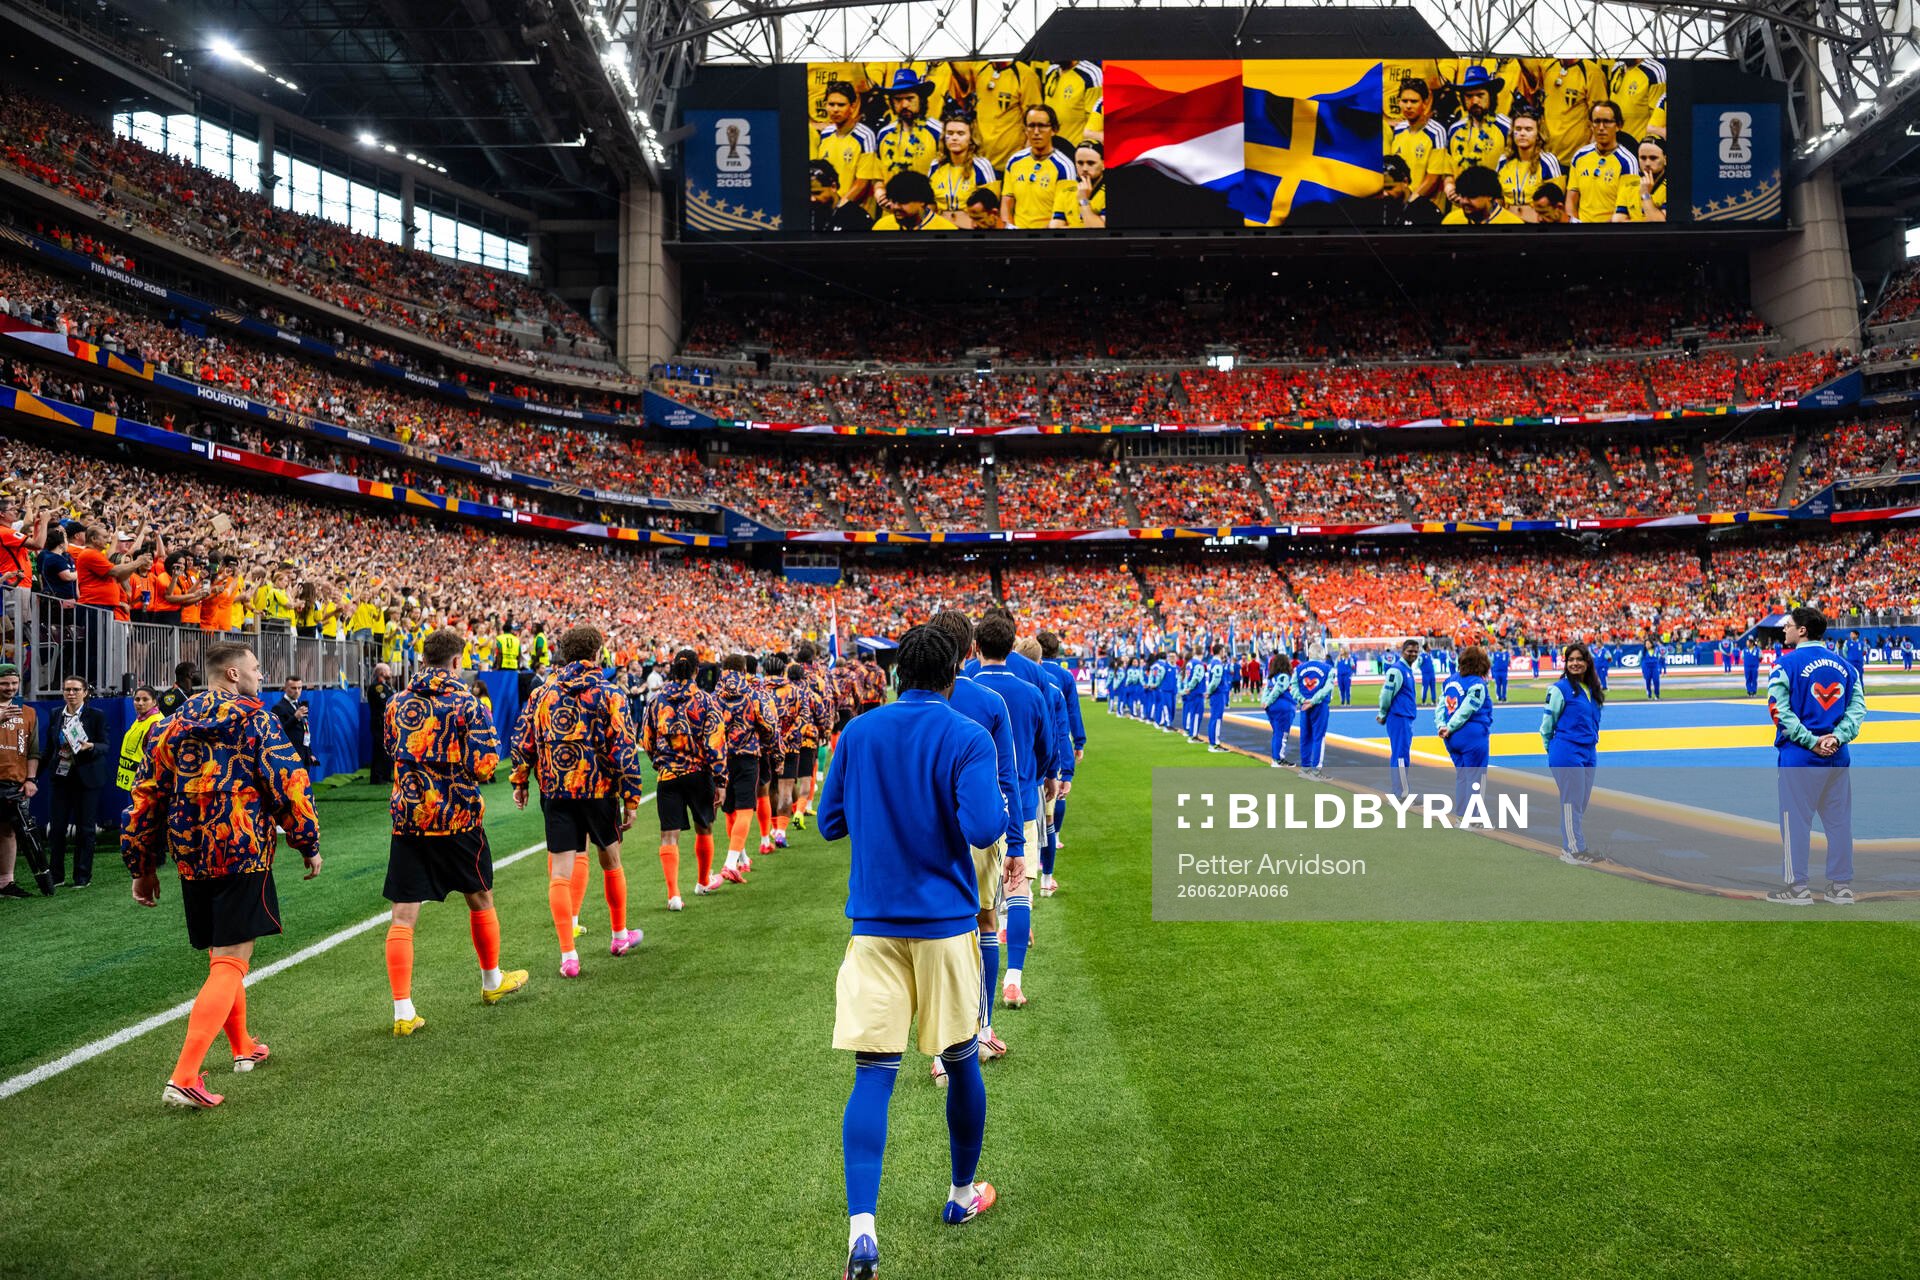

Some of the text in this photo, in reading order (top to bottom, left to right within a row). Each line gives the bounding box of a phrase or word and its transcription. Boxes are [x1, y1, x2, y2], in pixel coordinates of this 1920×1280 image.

[717, 179, 752, 187] 2026
[1718, 170, 1752, 178] 2026
[91, 262, 167, 298] FIFA WORLD CUP 2026
[405, 371, 439, 388] HOUSTON
[197, 386, 248, 410] HOUSTON
[1801, 658, 1848, 678] VOLUNTEER
